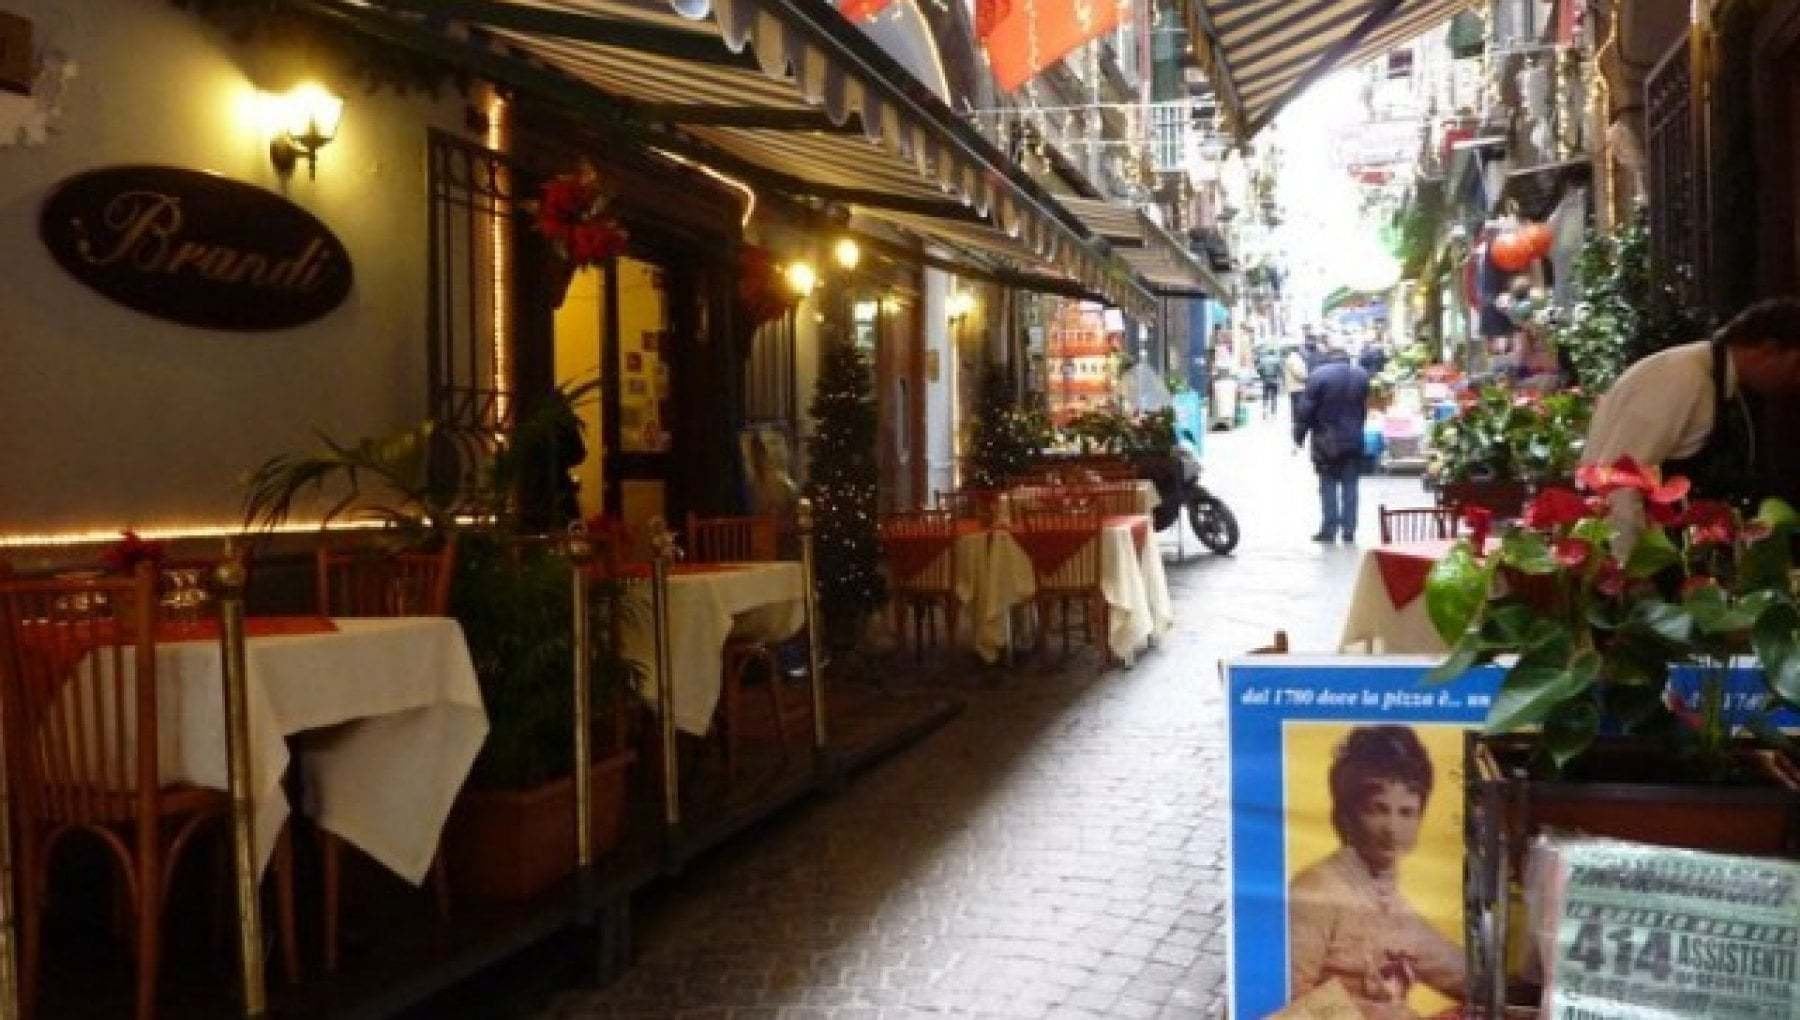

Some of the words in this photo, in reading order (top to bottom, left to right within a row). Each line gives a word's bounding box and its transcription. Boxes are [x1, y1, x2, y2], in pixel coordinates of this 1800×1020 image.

[84, 191, 329, 286] Brandi
[1381, 689, 1434, 711] pizza
[1566, 915, 1671, 981] 414
[1677, 934, 1797, 982] ASSISTENTI
